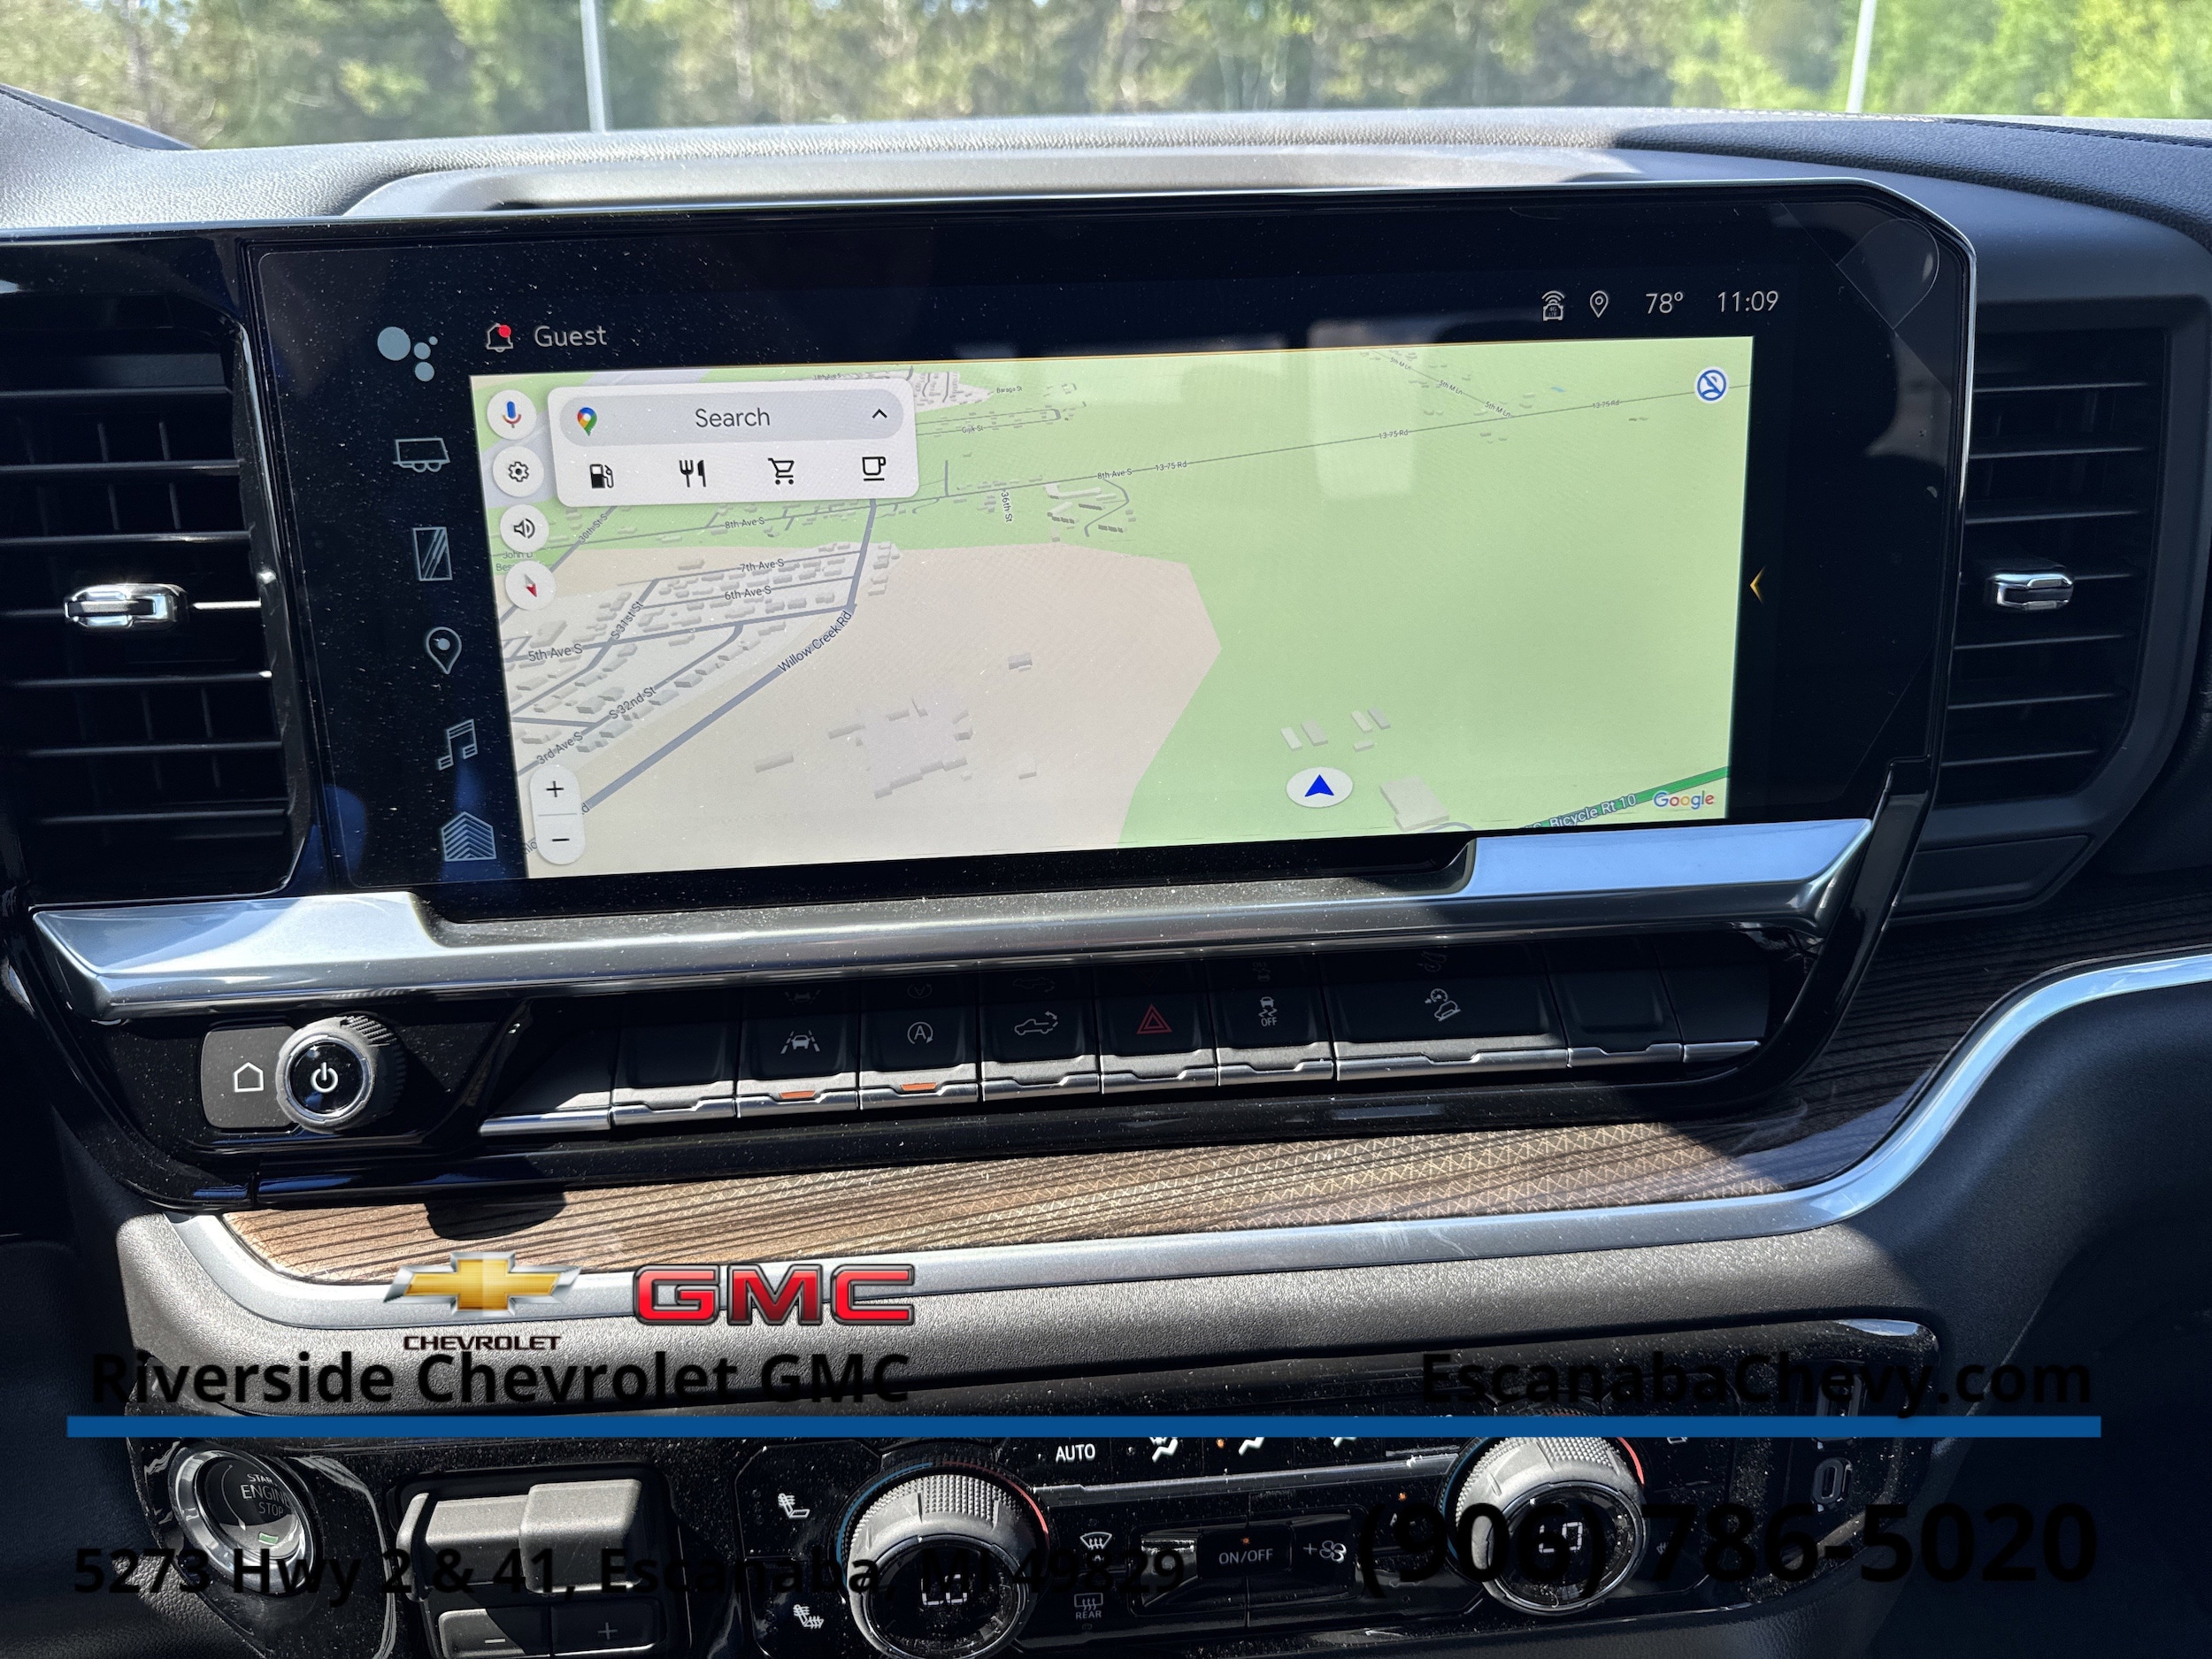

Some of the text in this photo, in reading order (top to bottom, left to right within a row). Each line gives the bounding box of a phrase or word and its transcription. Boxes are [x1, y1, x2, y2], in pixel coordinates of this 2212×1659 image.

[1717, 289, 1778, 312] 11:09
[534, 325, 608, 348] Guest
[1439, 380, 1449, 389] 5th
[695, 407, 771, 428] Search
[1485, 401, 1495, 411] 5th
[1495, 405, 1503, 414] M
[1177, 460, 1187, 469] Rd
[1001, 491, 1013, 523] 36th St
[579, 513, 608, 544] 30th St S
[725, 516, 765, 529] 8th Ave S
[740, 558, 785, 572] 7th Ave S
[725, 585, 772, 601] 6th Ave S
[611, 600, 644, 640] S 31st St
[778, 610, 852, 672] Willow Creek Rd
[527, 643, 583, 662] 5th Ave S
[609, 686, 657, 719] S 32nd St
[536, 731, 584, 764] 3rd Ave S
[1653, 789, 1715, 810] Google
[1549, 806, 1598, 827] Bicycle
[1601, 801, 1616, 814] Rt
[1619, 794, 1637, 809] 10
[1260, 1017, 1278, 1027] OFF
[1055, 1442, 1096, 1463] AUTO
[247, 1473, 278, 1486] STAR
[258, 1502, 284, 1517] STOP
[1218, 1548, 1274, 1565] ON/OFF
[1075, 1609, 1102, 1620] REAR
